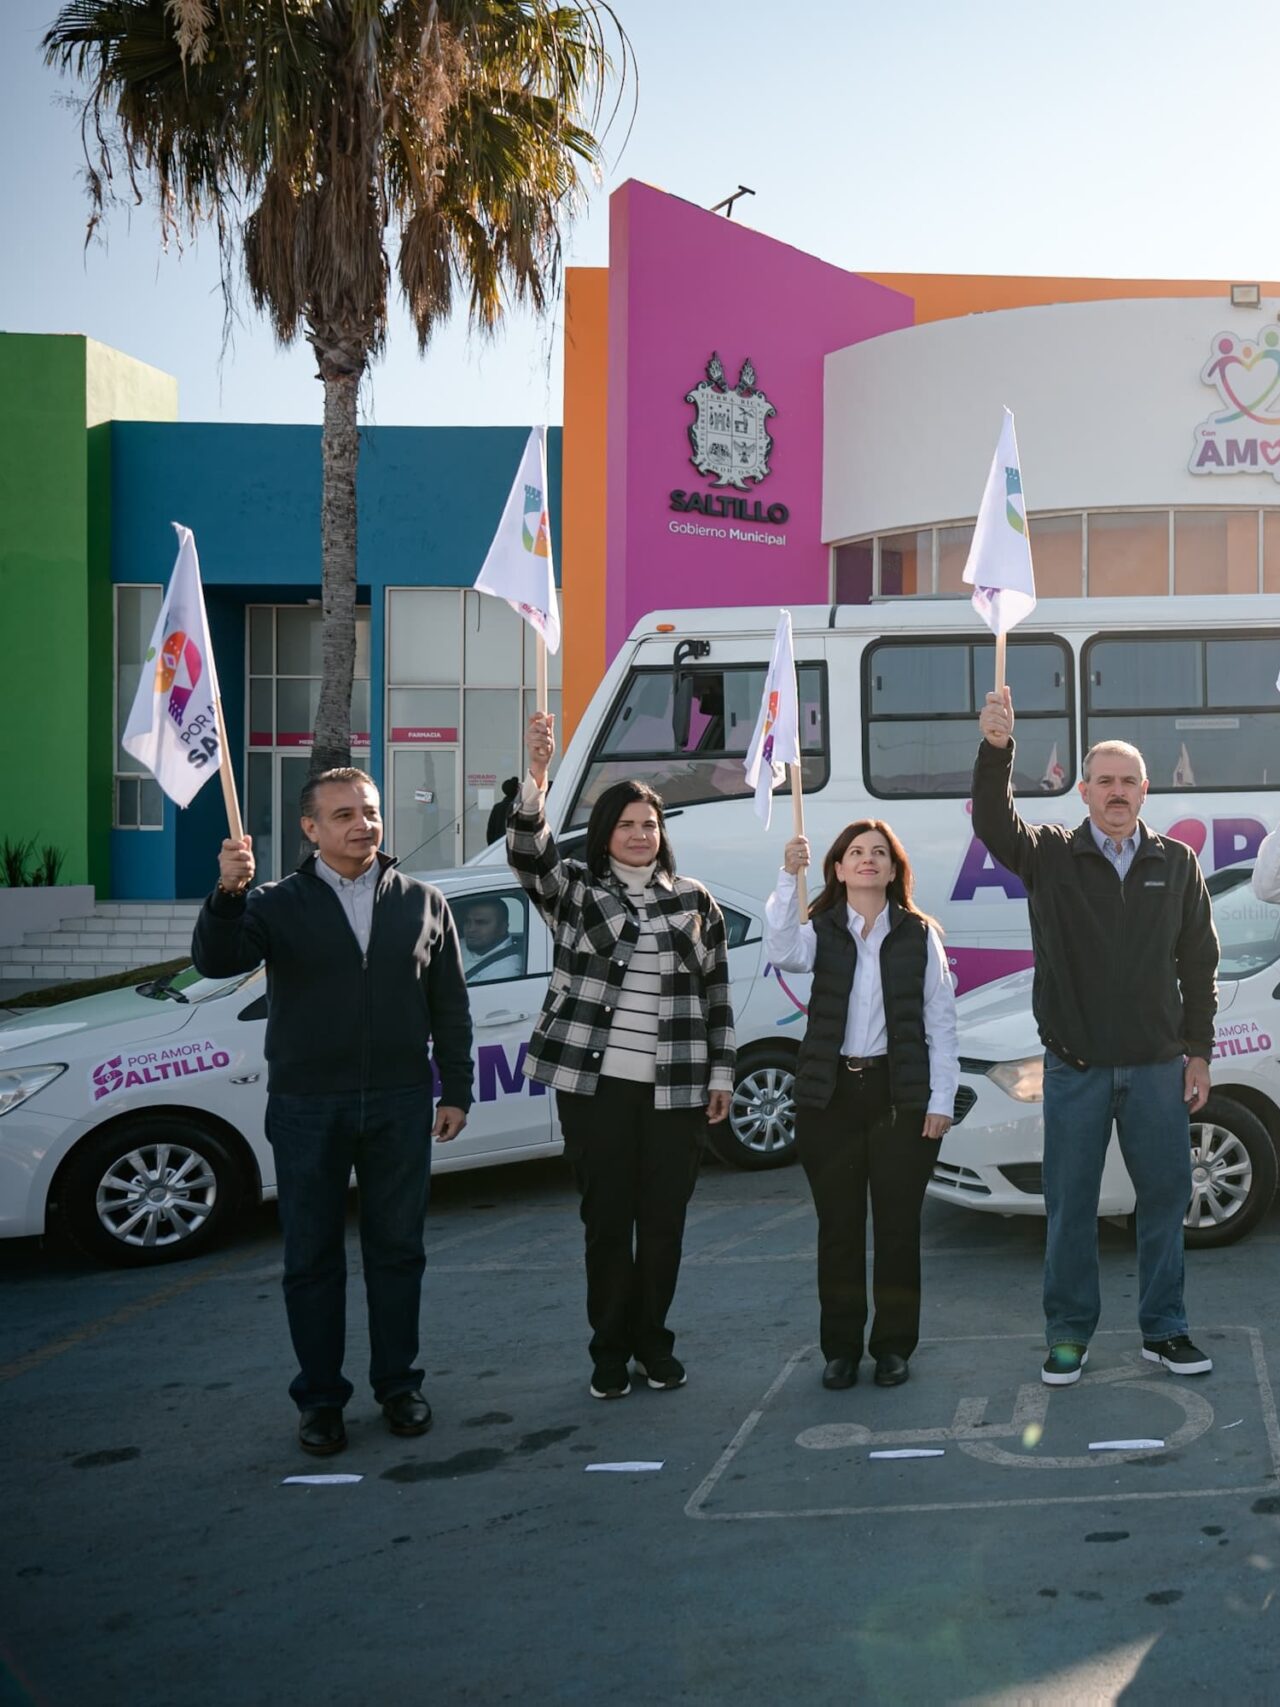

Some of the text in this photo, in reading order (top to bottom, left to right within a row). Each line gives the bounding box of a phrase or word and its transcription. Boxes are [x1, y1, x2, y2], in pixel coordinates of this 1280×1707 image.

[670, 489, 789, 525] SALTILLO
[669, 521, 787, 546] Gobierno Municipal
[180, 714, 212, 744] POR
[1221, 904, 1279, 920] Saltillo
[1218, 1022, 1259, 1037] AMOR A
[128, 1041, 214, 1067] POR AMOR A
